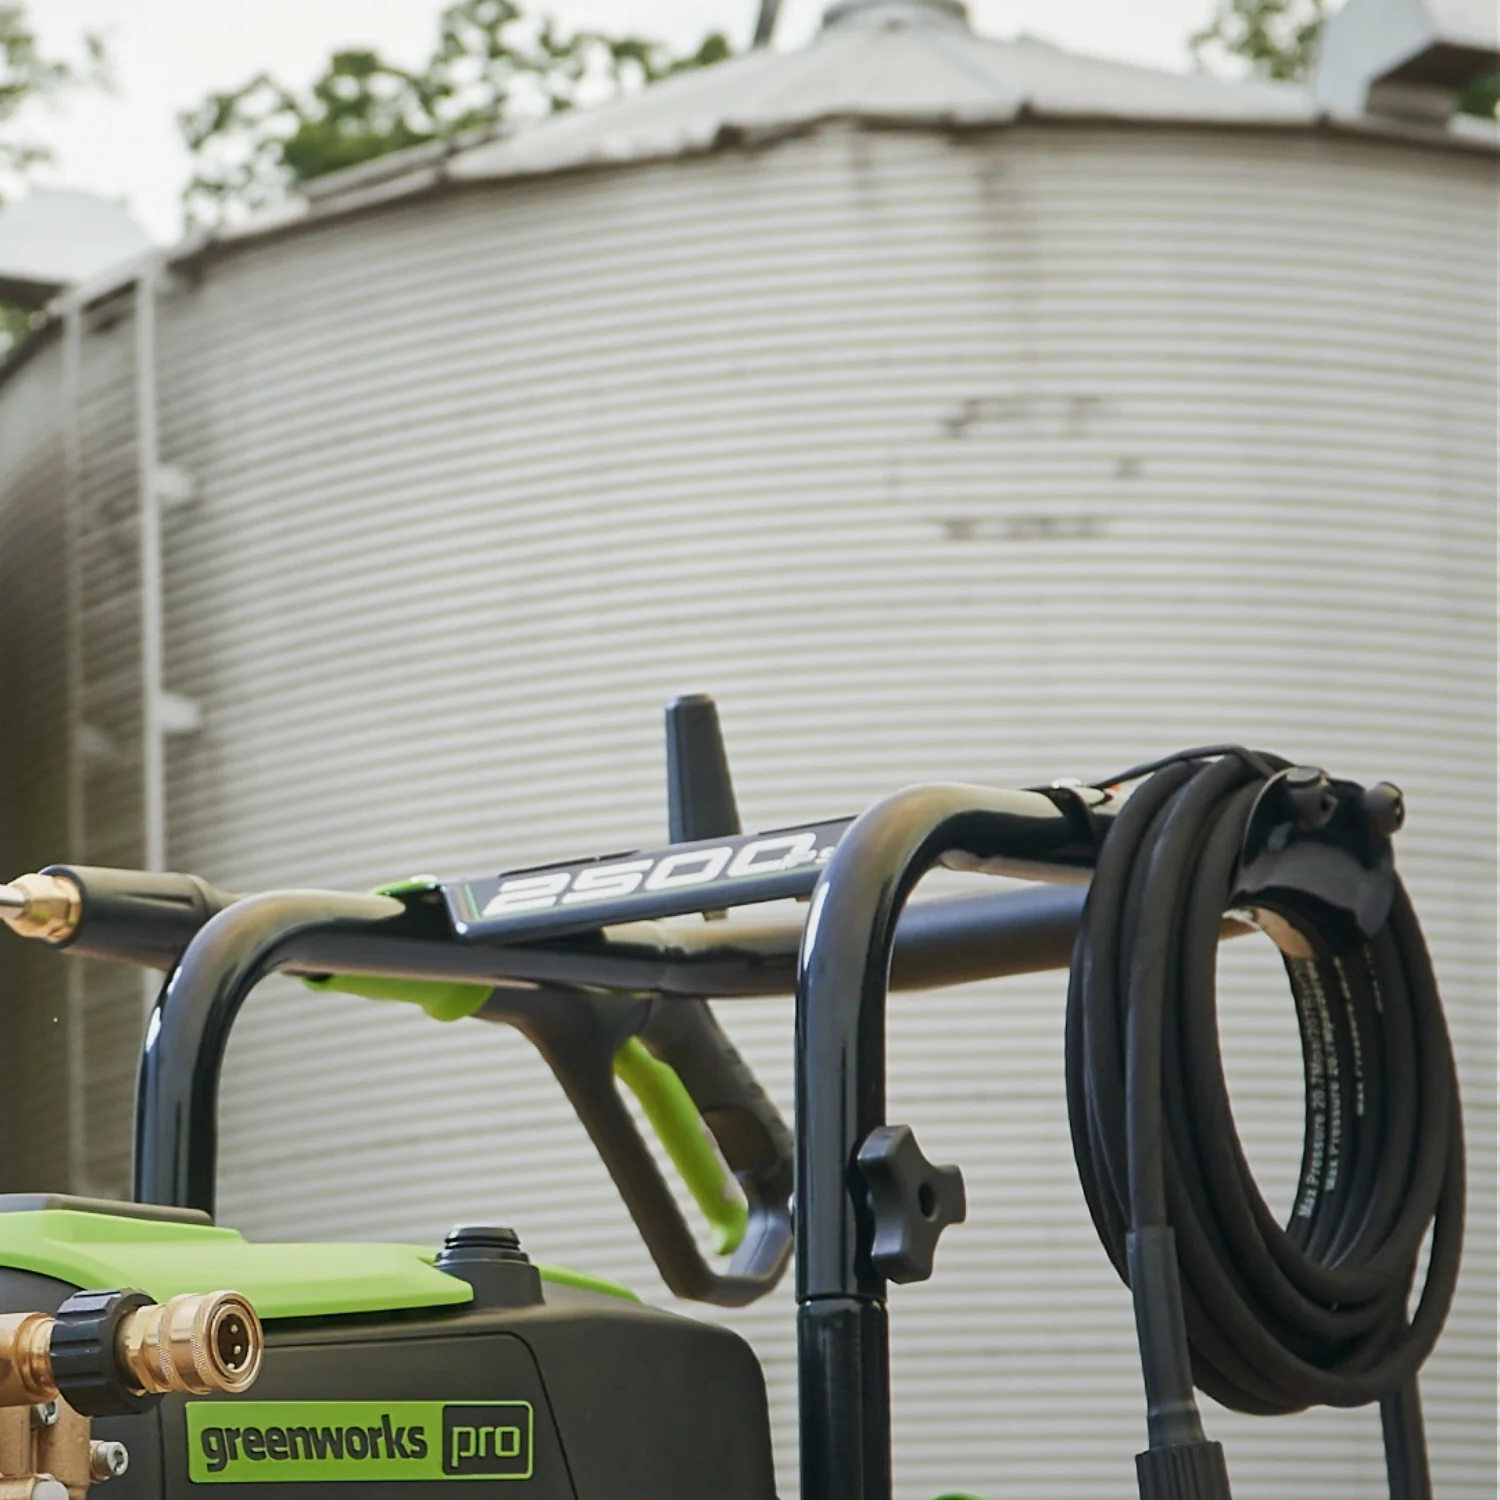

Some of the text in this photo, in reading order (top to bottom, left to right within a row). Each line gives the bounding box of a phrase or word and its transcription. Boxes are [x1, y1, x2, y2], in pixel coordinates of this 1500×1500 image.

[481, 831, 816, 918] 2500
[1305, 1114, 1326, 1186] Pressure
[202, 1413, 521, 1473] greenworks pro
